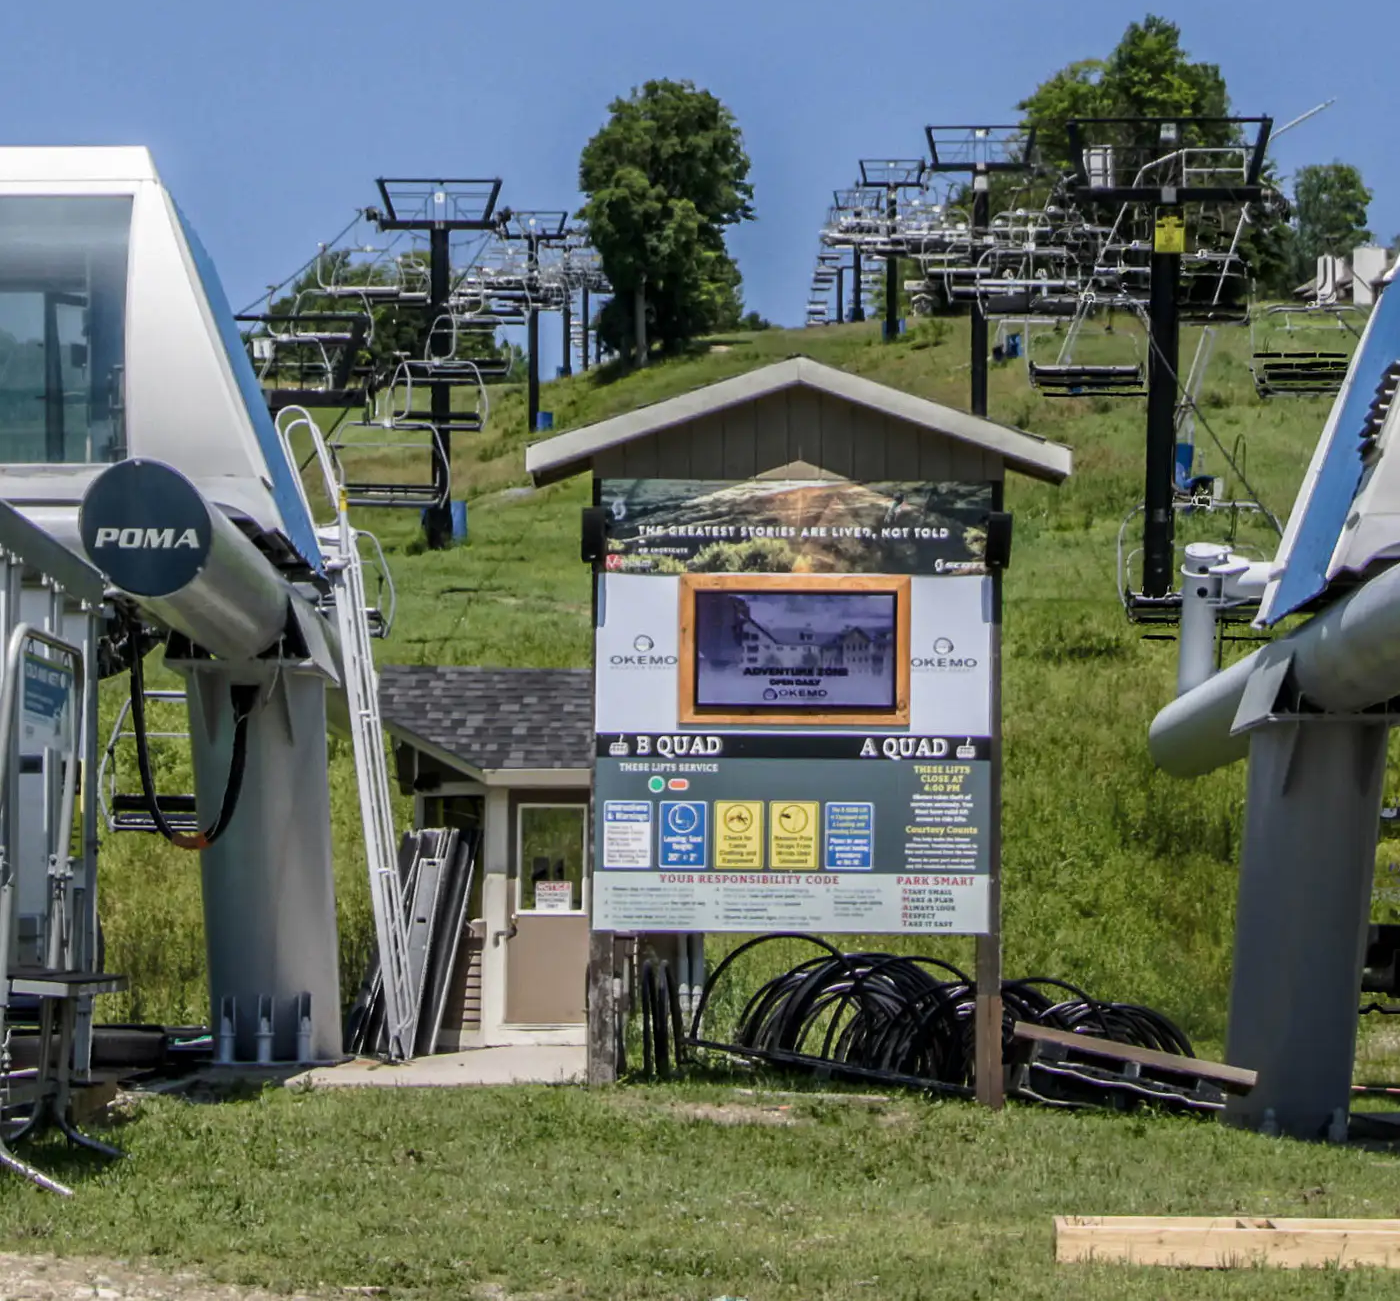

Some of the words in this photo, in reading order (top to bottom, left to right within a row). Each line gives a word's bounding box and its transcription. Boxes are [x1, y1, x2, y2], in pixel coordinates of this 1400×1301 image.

[638, 525, 664, 537] THE
[668, 525, 736, 538] GREATEST
[740, 526, 796, 538] STORIES
[800, 527, 829, 539] ARE
[881, 527, 910, 539] NOT
[914, 527, 949, 539] TOLD
[94, 527, 200, 550] POMA
[610, 655, 678, 665] OKEMO
[910, 657, 978, 668] OKEMO
[743, 666, 815, 677] ADVENTURE
[778, 688, 828, 698] OKEMO
[636, 735, 651, 755] B
[656, 735, 723, 759] QUAD
[860, 737, 878, 757] A
[882, 737, 949, 760] QUAD
[619, 762, 650, 772] THESE
[651, 763, 676, 772] LIFTS
[679, 763, 719, 773] SERVICE
[913, 765, 944, 774] THESE
[945, 766, 971, 775] LIFTS
[920, 774, 949, 783] CLOSE
[951, 775, 965, 783] AT
[946, 784, 961, 792] PM
[905, 825, 945, 836] Courtesy
[946, 826, 978, 835] Counts
[659, 874, 695, 884] YOUR
[699, 874, 802, 885] RESPONSIBILITY
[805, 875, 840, 885] CODE
[896, 876, 930, 886] PARK
[932, 877, 975, 887] SMART
[902, 888, 926, 896] START
[902, 896, 925, 904] MAKE
[902, 904, 935, 912] ALWAYS
[902, 912, 936, 920] RESPECT
[902, 920, 923, 928] TAKE
